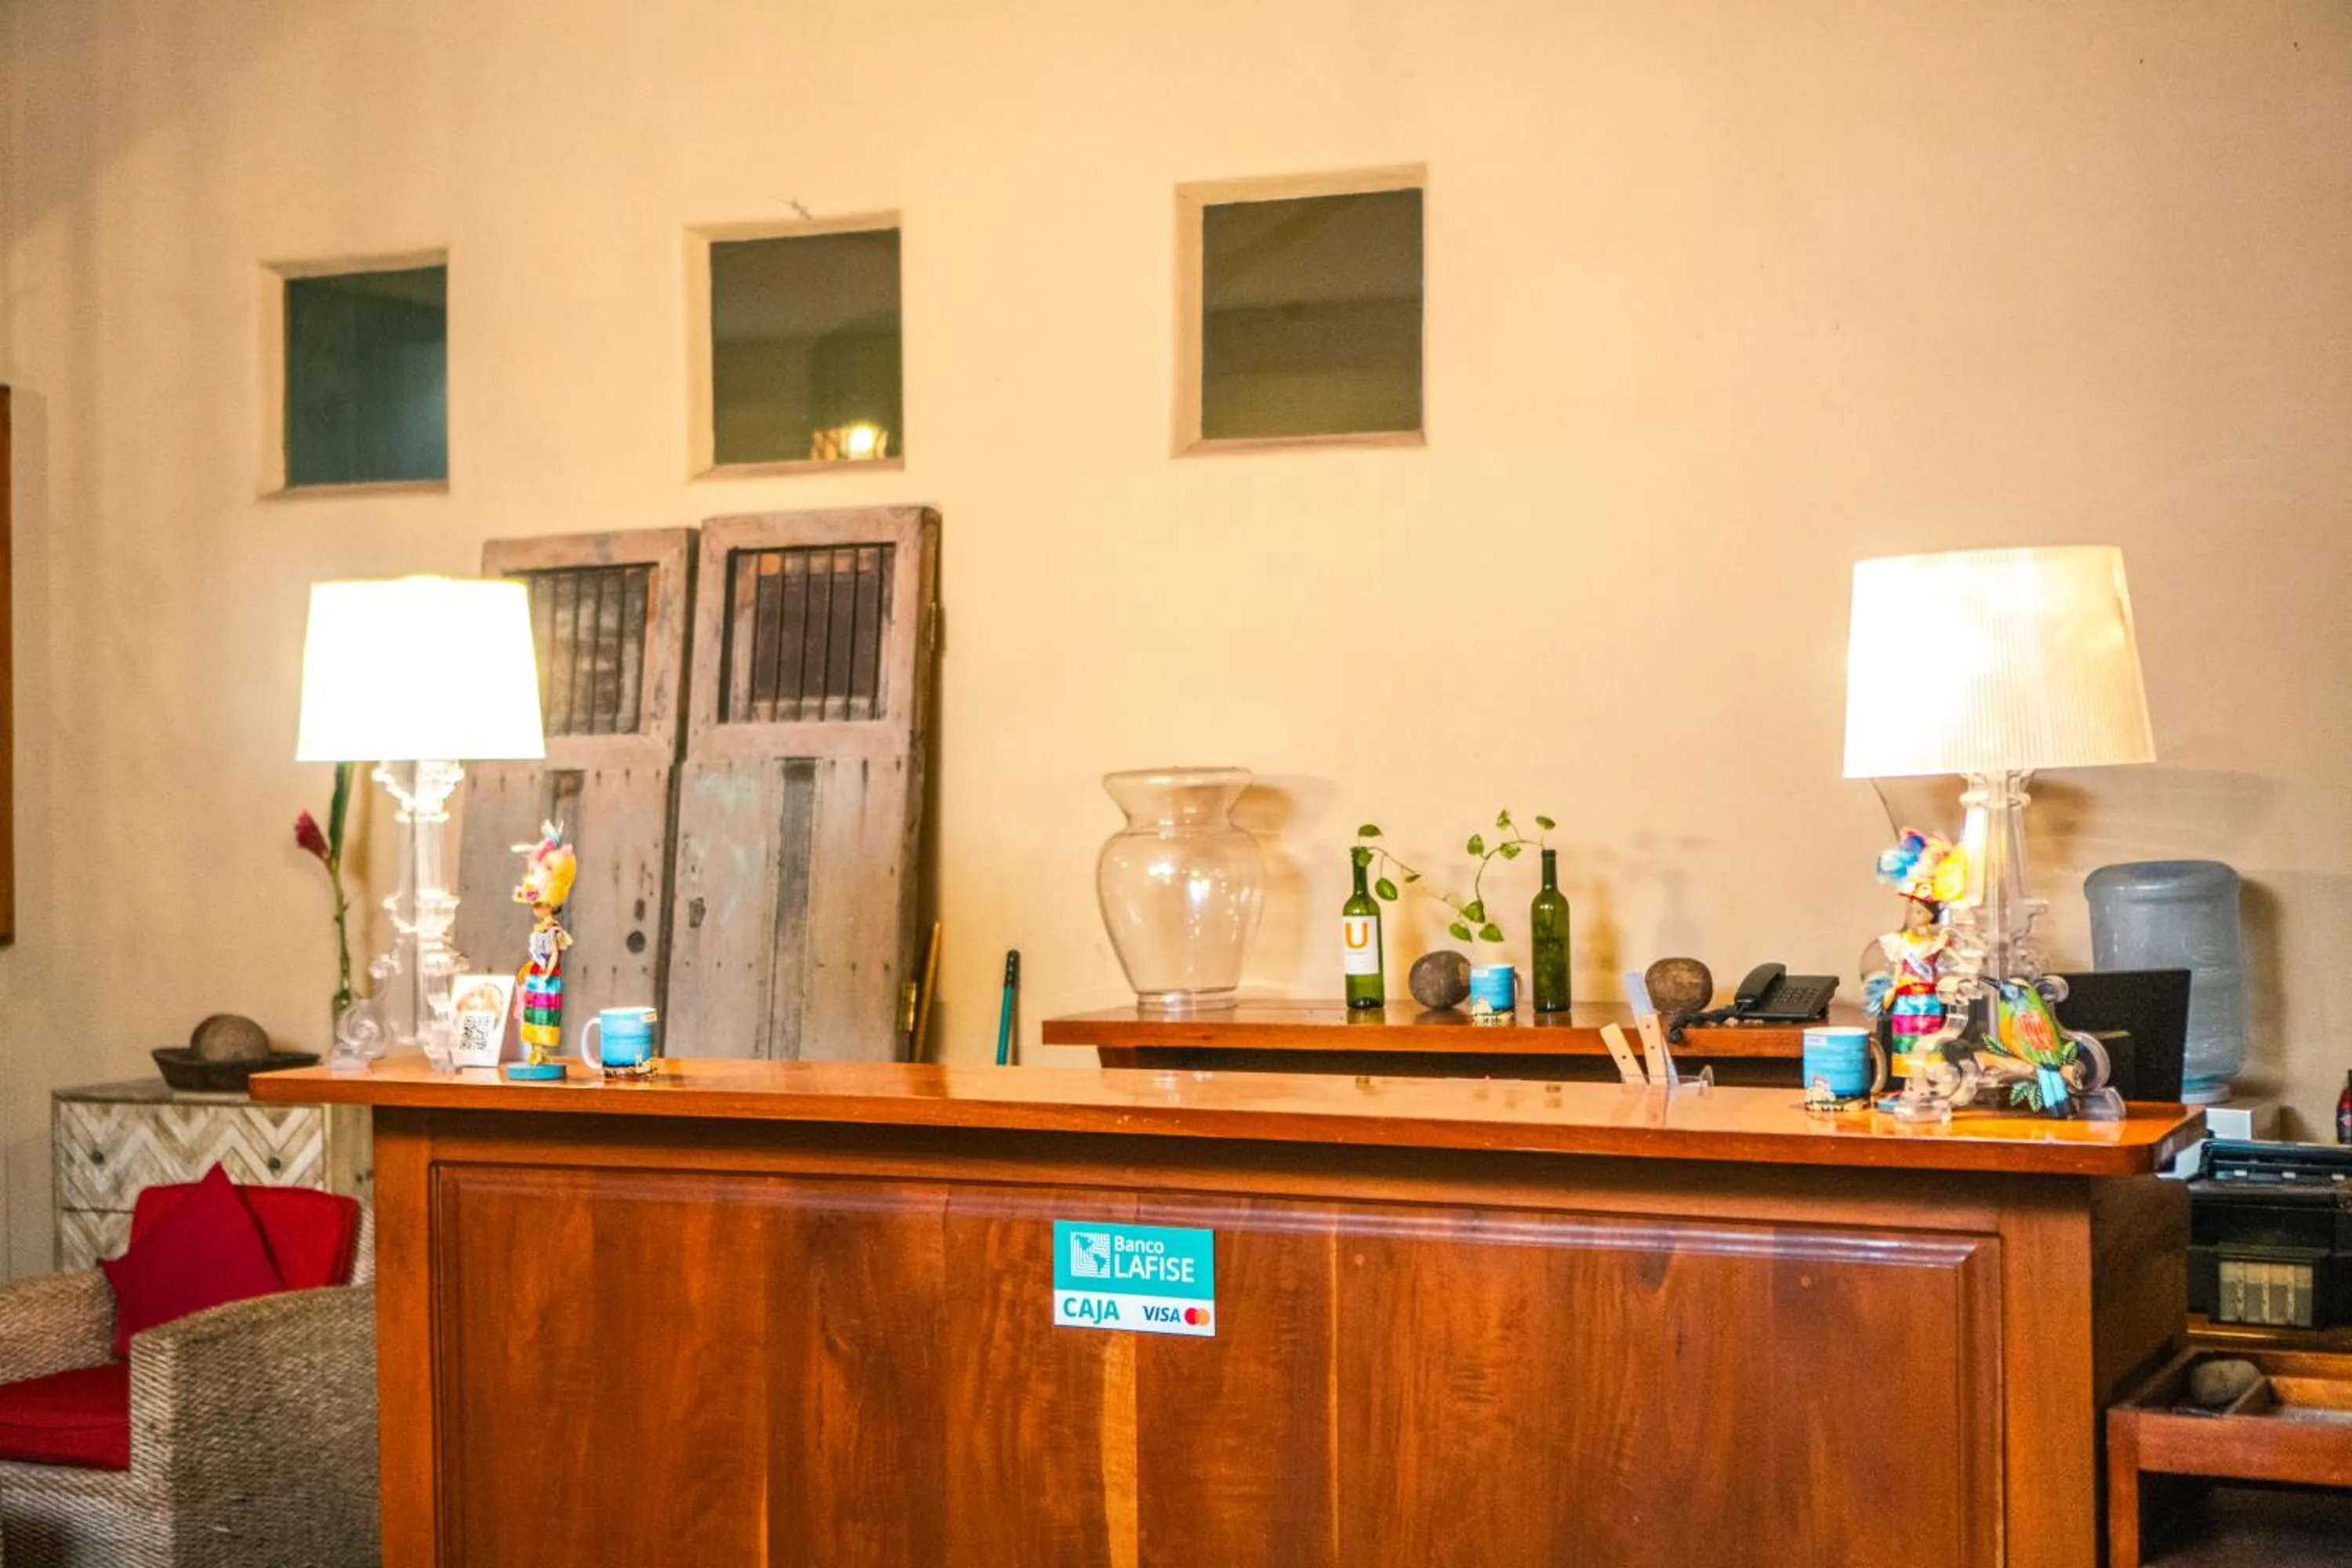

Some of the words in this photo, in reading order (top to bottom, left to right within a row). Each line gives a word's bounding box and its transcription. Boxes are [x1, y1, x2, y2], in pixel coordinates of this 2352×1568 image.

[1345, 923, 1368, 949] U
[1114, 1235, 1164, 1254] Banco
[1115, 1254, 1195, 1283] LAFISE
[1063, 1298, 1120, 1324] CAJA
[1142, 1305, 1181, 1323] VISA
